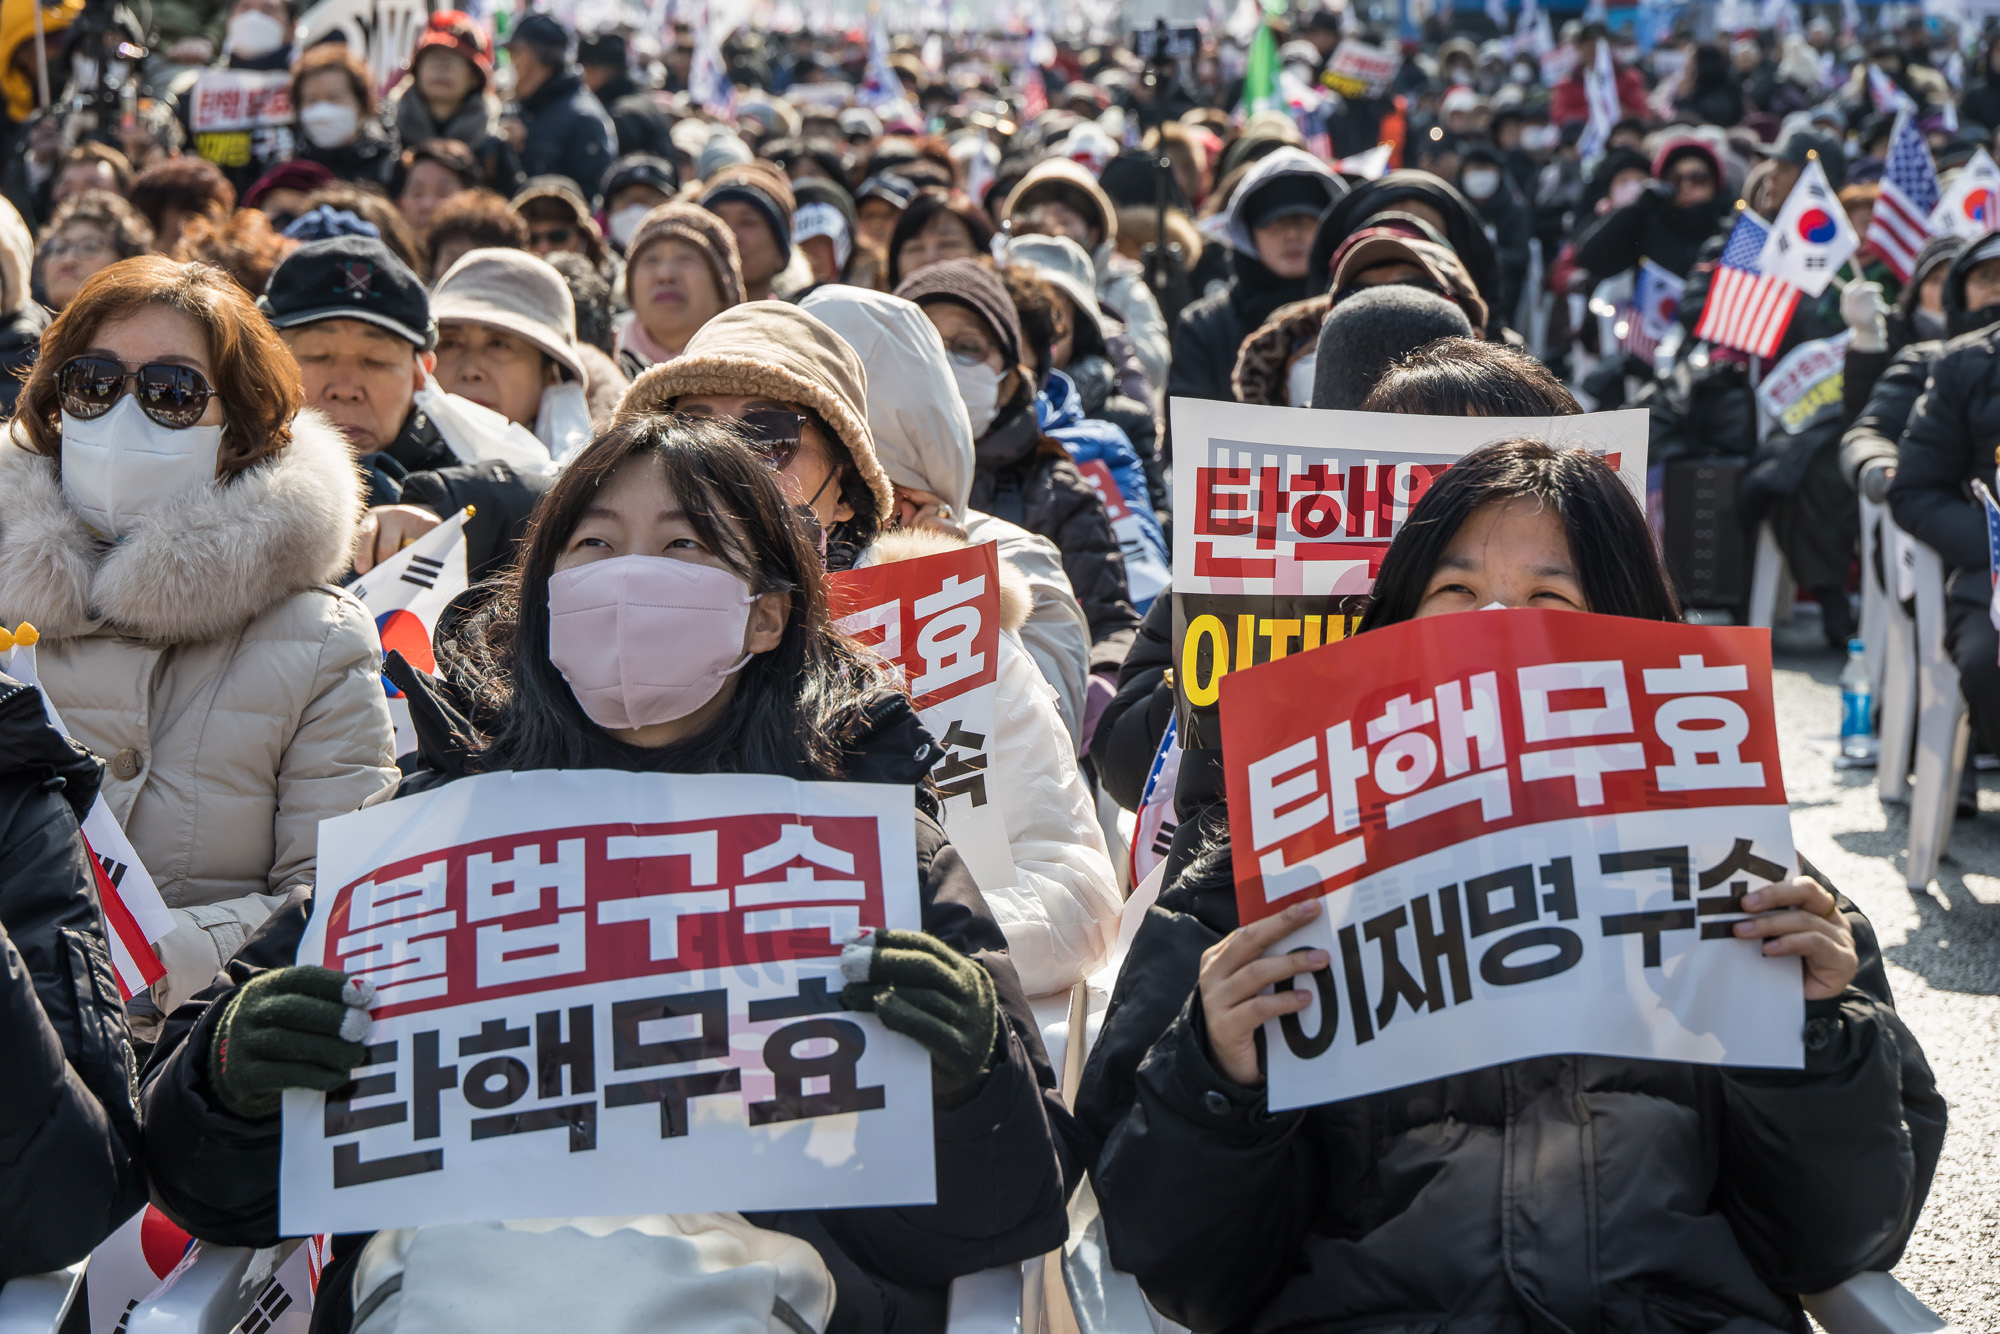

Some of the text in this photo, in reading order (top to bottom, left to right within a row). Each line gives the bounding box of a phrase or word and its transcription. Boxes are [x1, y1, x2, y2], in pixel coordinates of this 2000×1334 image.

[1248, 654, 1766, 903] 탄핵무효
[336, 824, 866, 1004] 불법구속
[1274, 856, 1584, 1059] 이재명
[324, 976, 886, 1189] 탄핵무효
